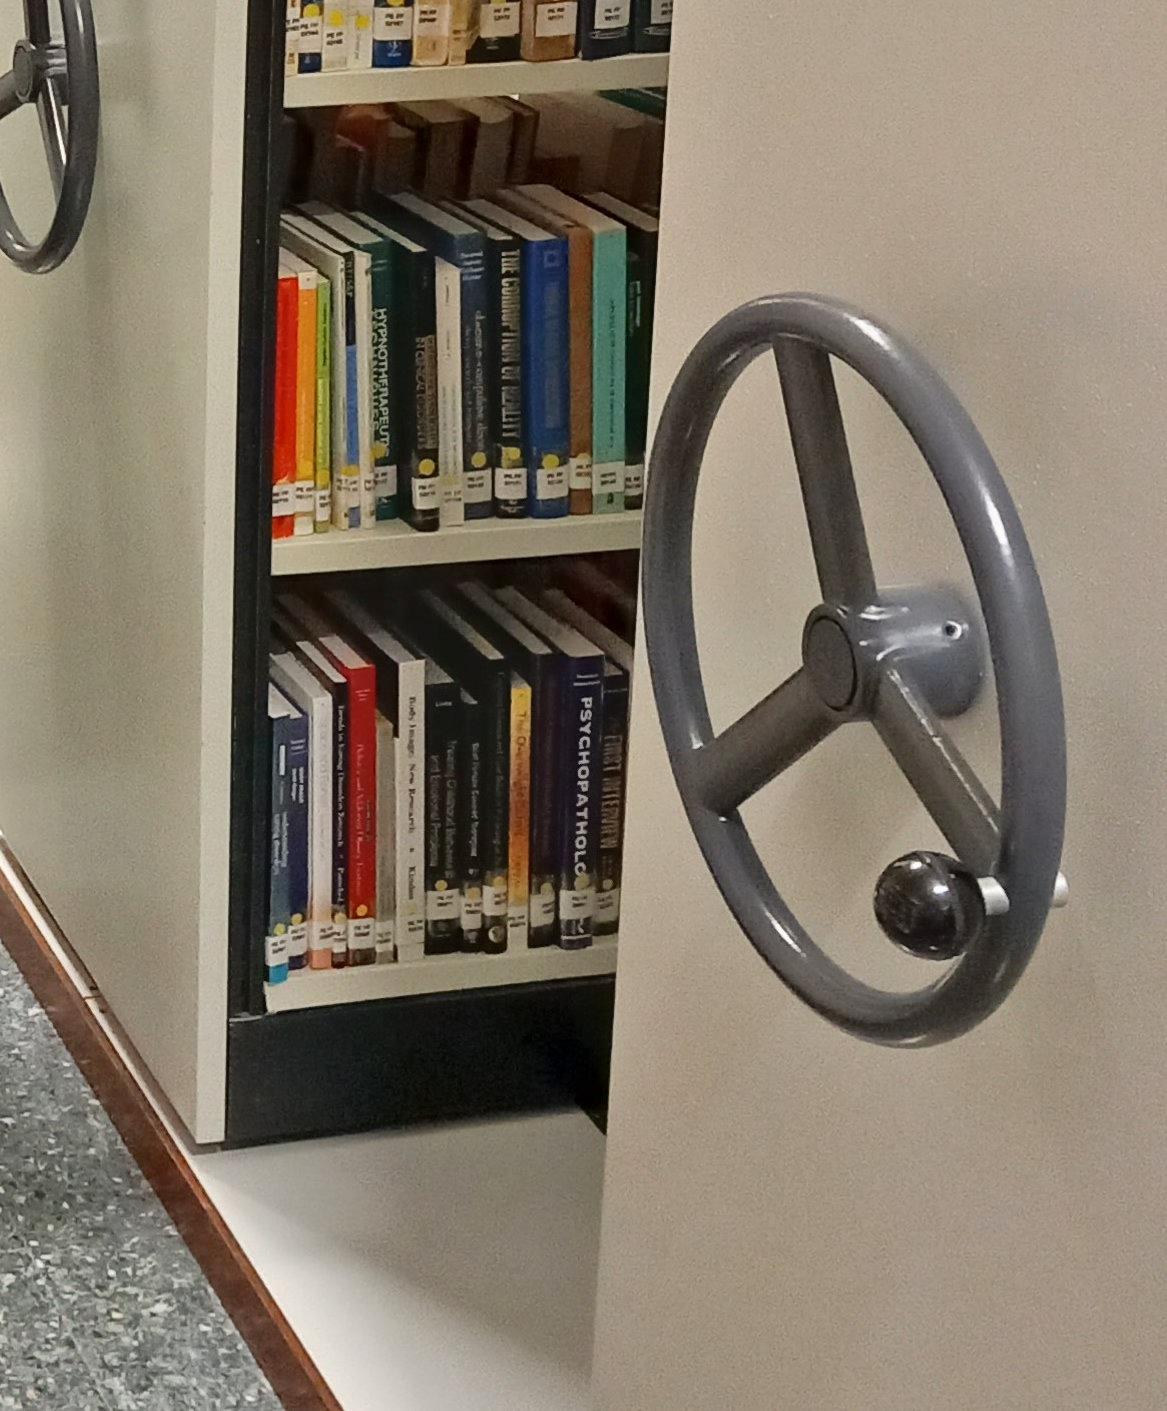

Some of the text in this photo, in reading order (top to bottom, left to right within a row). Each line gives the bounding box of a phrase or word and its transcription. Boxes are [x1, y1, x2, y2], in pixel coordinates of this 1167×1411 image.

[501, 248, 521, 272] THE
[501, 276, 521, 362] CORRUPTION
[501, 365, 521, 380] OF
[407, 696, 417, 720] Body
[574, 696, 593, 876] PSYCHOPATHOLO
[600, 734, 623, 849] FIRST INTERVIEW
[408, 788, 416, 834] Research
